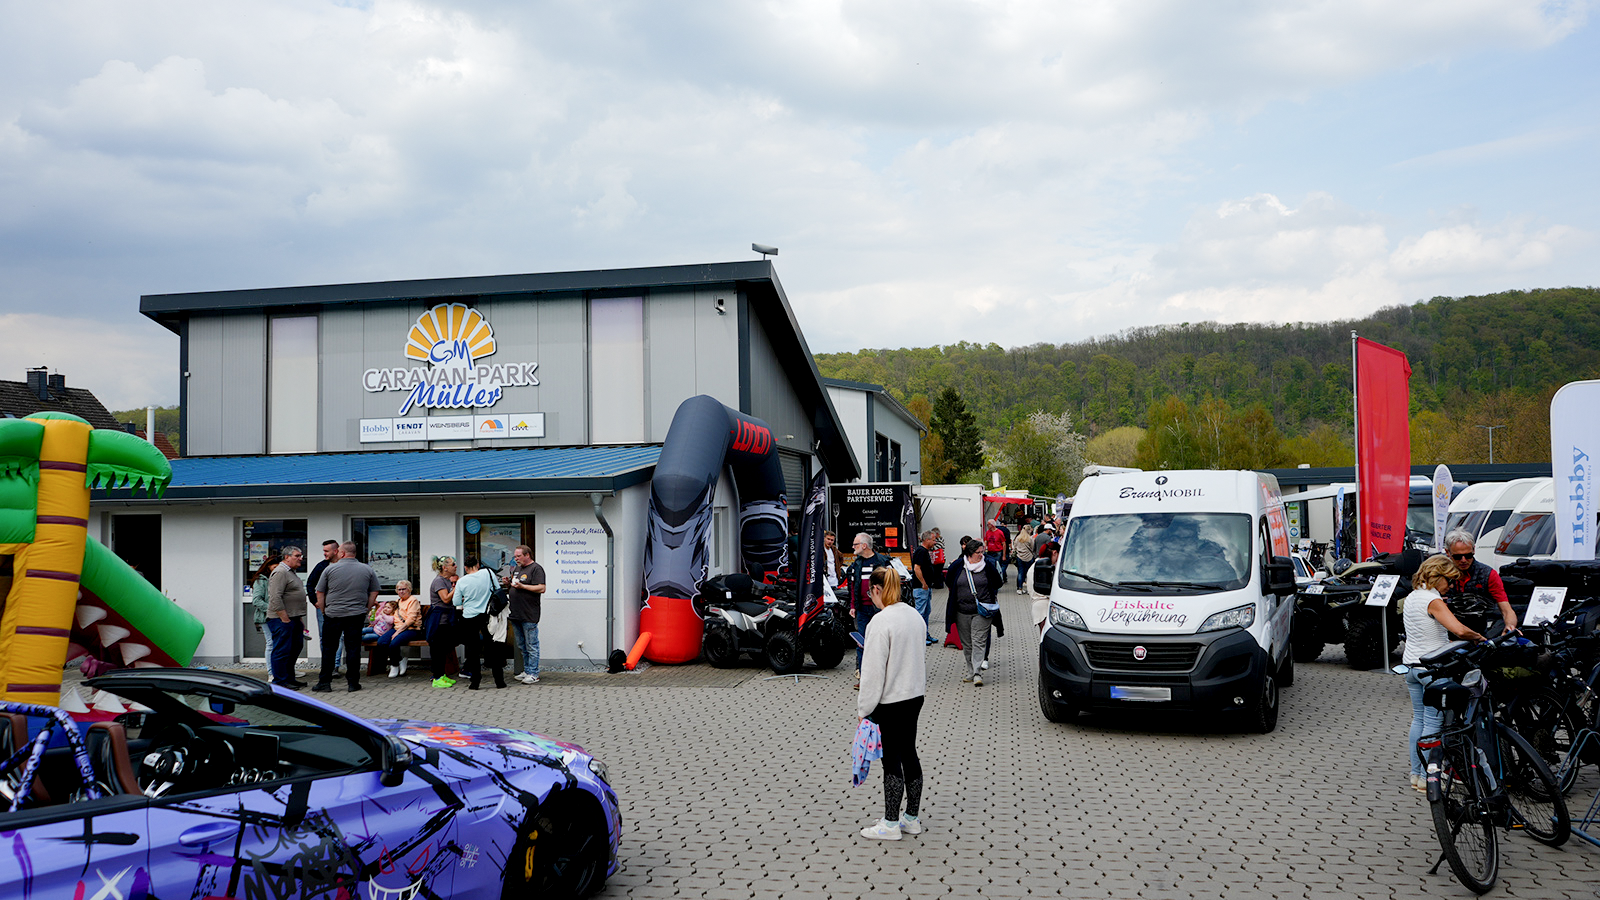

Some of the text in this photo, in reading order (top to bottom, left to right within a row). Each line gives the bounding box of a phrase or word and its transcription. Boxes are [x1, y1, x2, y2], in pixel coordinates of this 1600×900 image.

[364, 364, 538, 390] CARAVAN-PARK
[400, 381, 500, 413] Müller
[362, 424, 390, 434] Hobby
[396, 422, 424, 430] FENDT
[1568, 445, 1589, 546] Hobby
[1113, 600, 1175, 610] Eiskalte
[1096, 607, 1188, 627] Verführung
